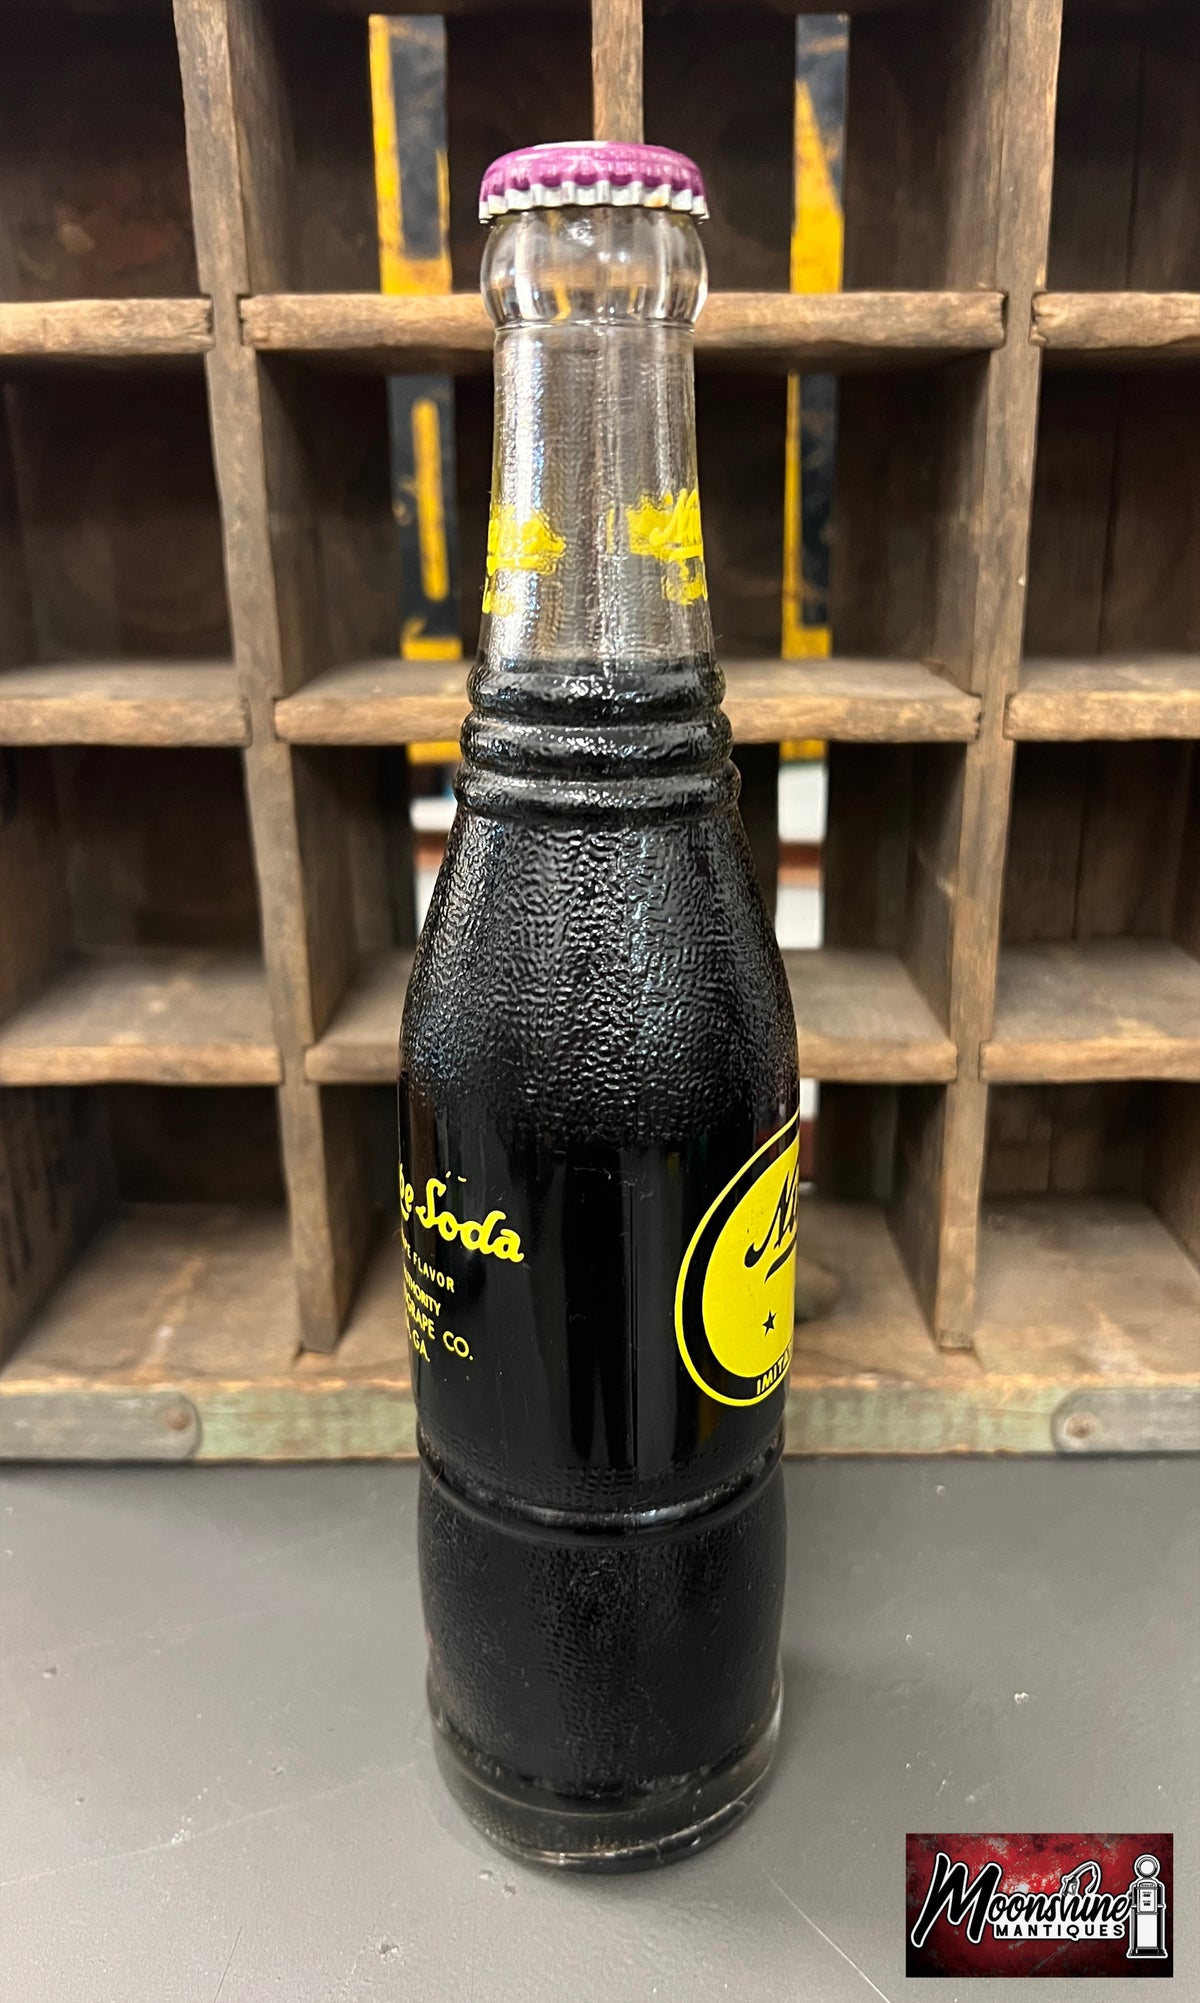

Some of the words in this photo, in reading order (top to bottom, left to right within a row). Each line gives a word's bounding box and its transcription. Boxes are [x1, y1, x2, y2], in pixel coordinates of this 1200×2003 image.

[415, 1178, 525, 1263] Soda
[404, 1264, 441, 1317] UTHORITY
[413, 1251, 455, 1293] FLAVOR
[404, 1283, 435, 1340] GRAPE
[443, 1331, 474, 1360] CO.
[412, 1329, 431, 1362] GA.
[756, 1341, 793, 1395] IMITA
